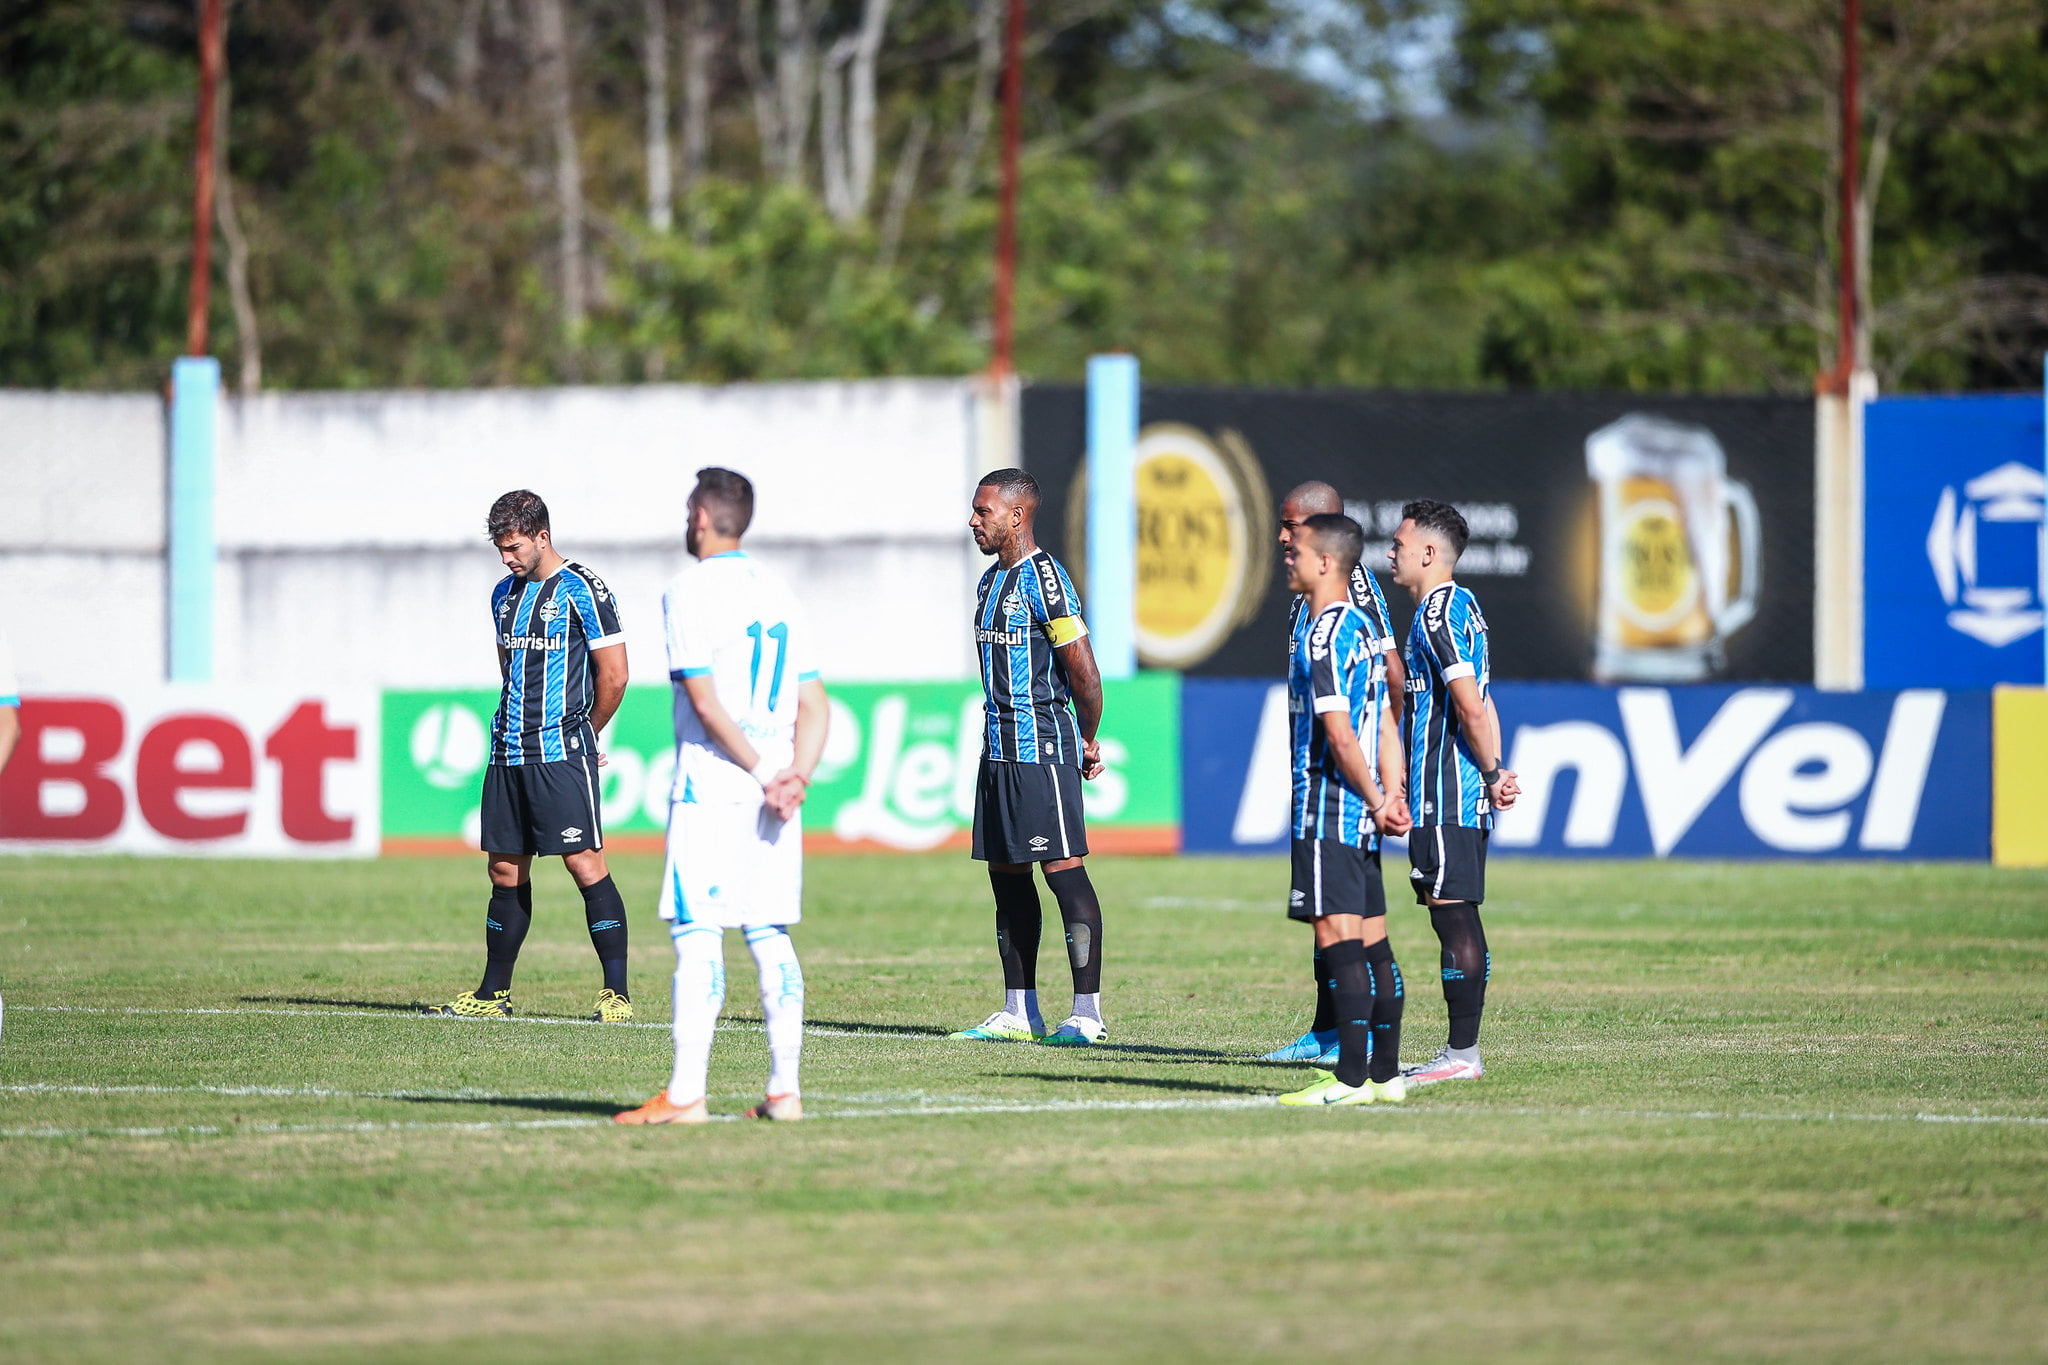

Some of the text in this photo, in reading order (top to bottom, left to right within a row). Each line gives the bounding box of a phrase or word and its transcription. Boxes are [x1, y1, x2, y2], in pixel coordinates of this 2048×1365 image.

[503, 632, 562, 651] Banrisul
[976, 625, 1022, 645] Banrisul
[747, 621, 788, 712] 11
[0, 694, 357, 842] Bet
